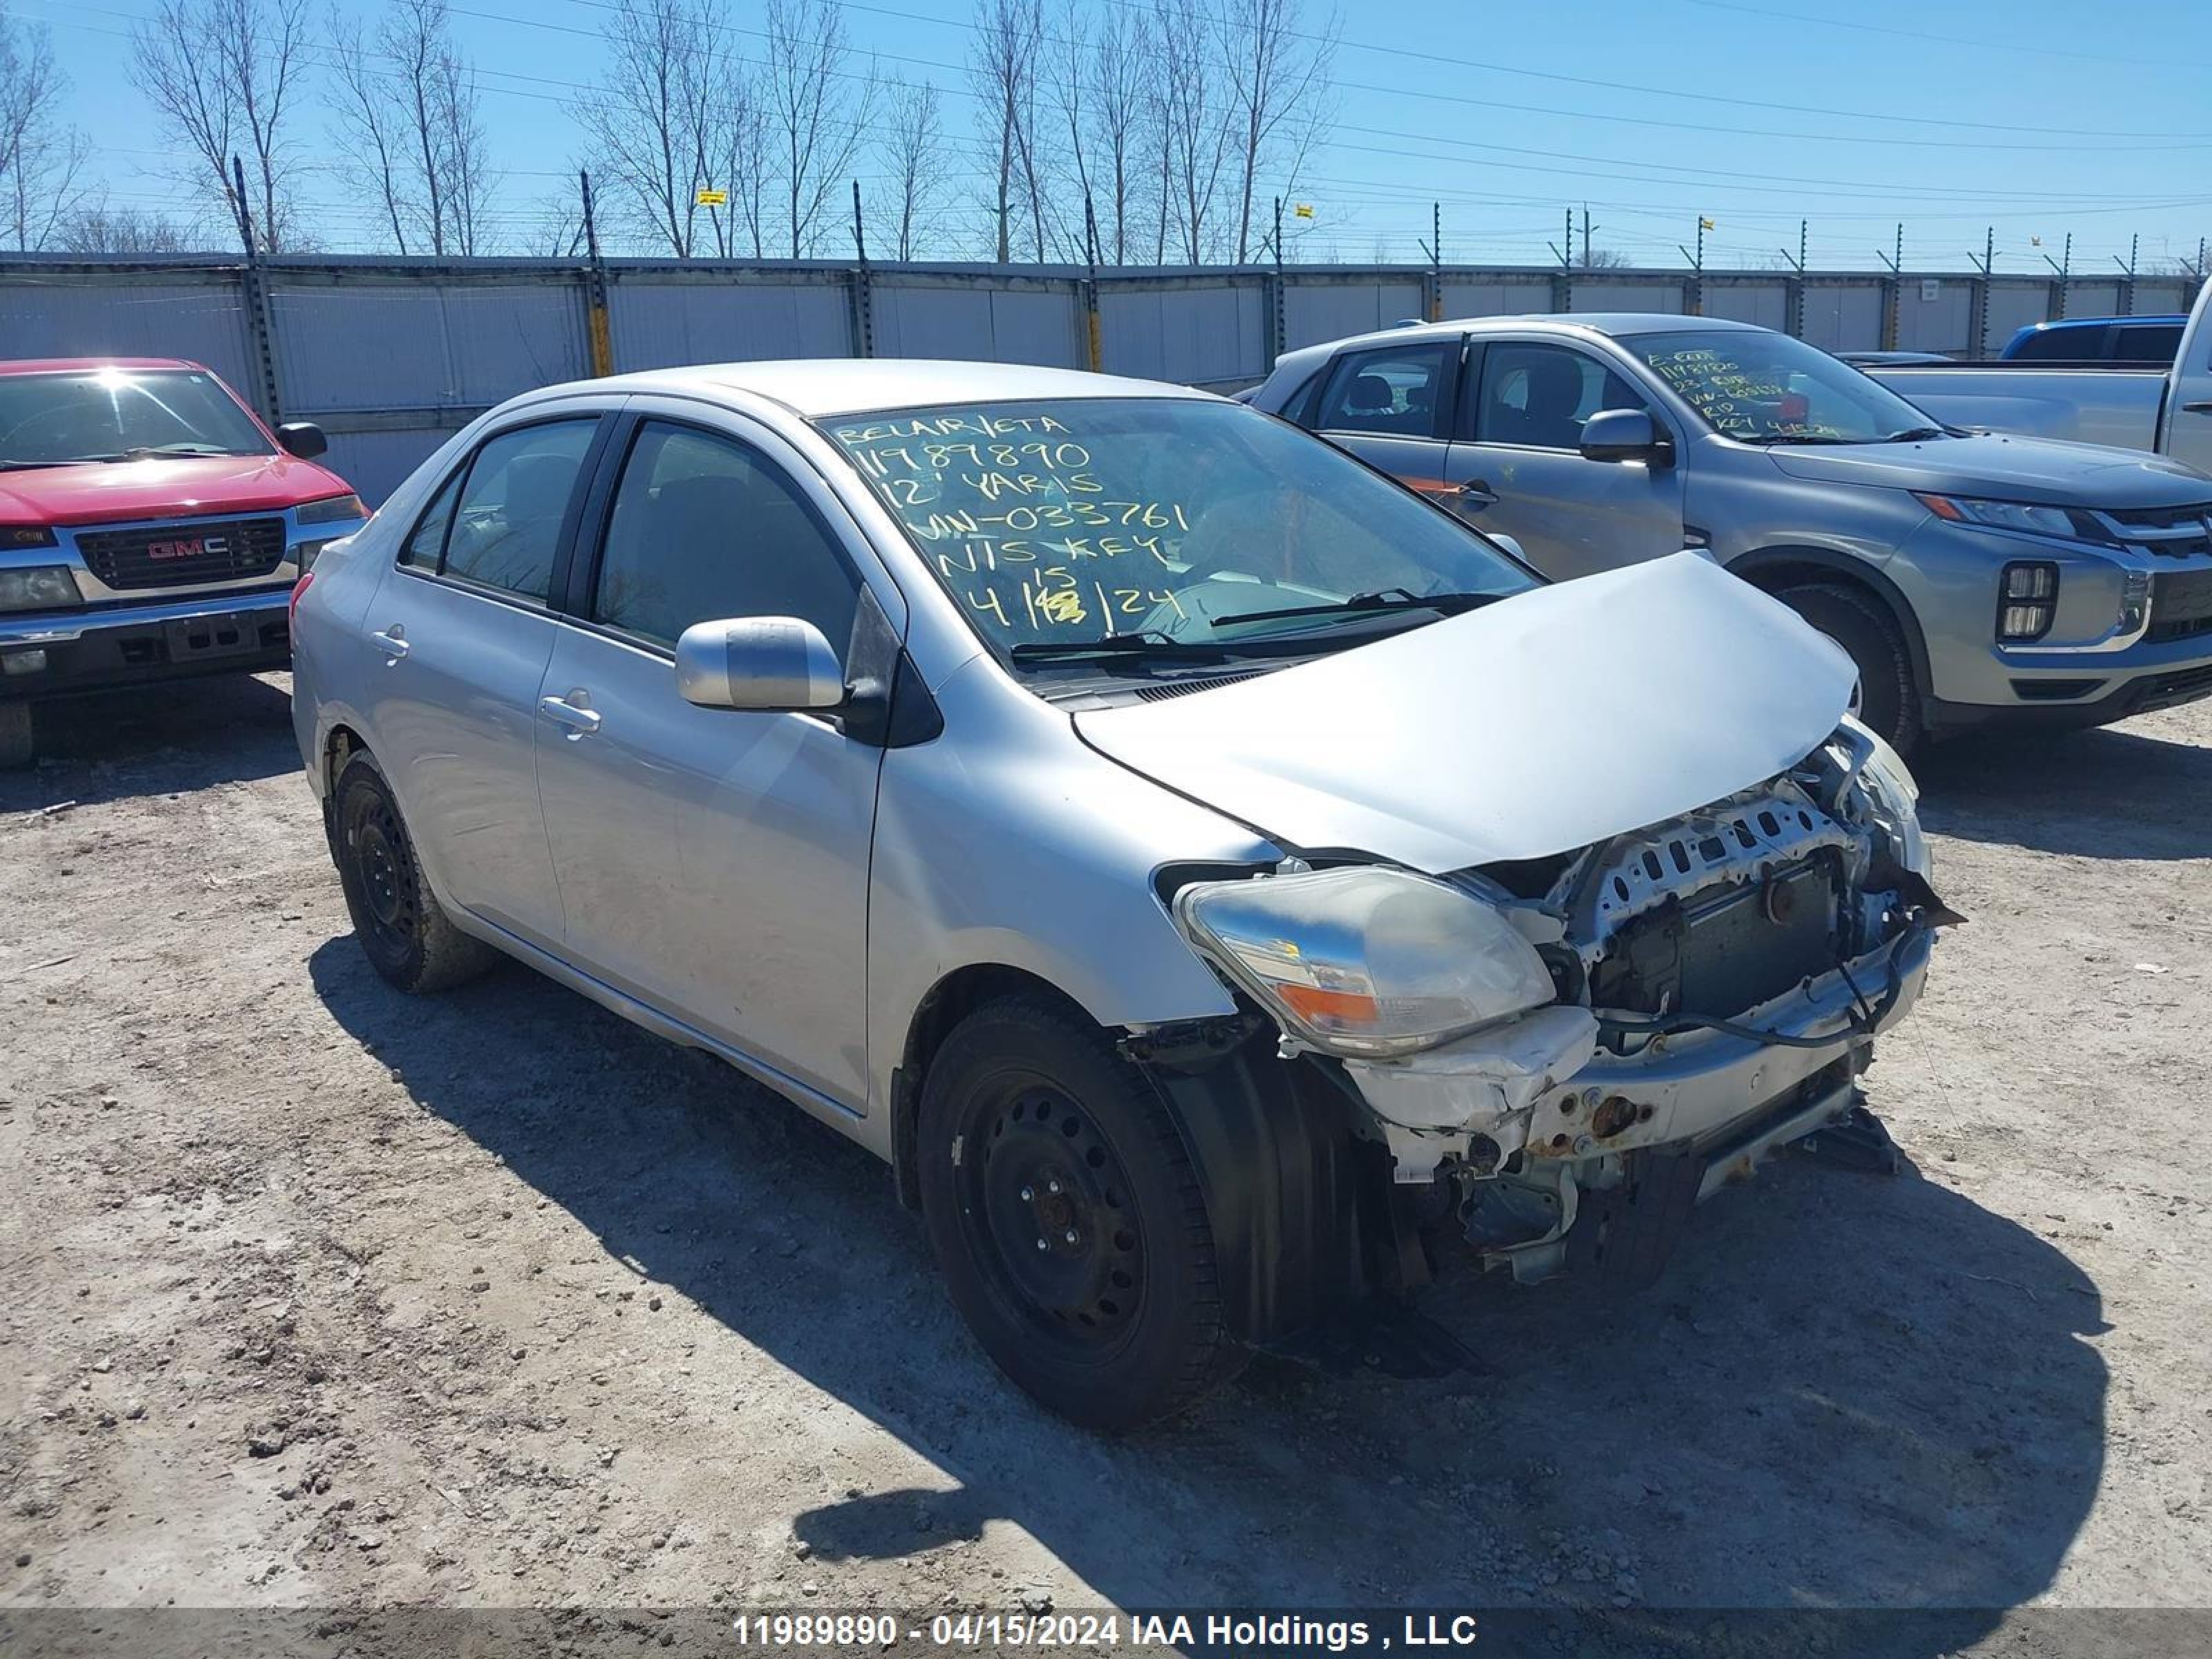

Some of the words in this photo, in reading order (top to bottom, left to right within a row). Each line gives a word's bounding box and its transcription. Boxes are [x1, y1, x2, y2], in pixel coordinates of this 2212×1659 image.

[855, 443, 1090, 478] 11989890
[962, 473, 1104, 500] YARIS
[147, 536, 228, 559] GMC
[1064, 535, 1177, 565] KEY
